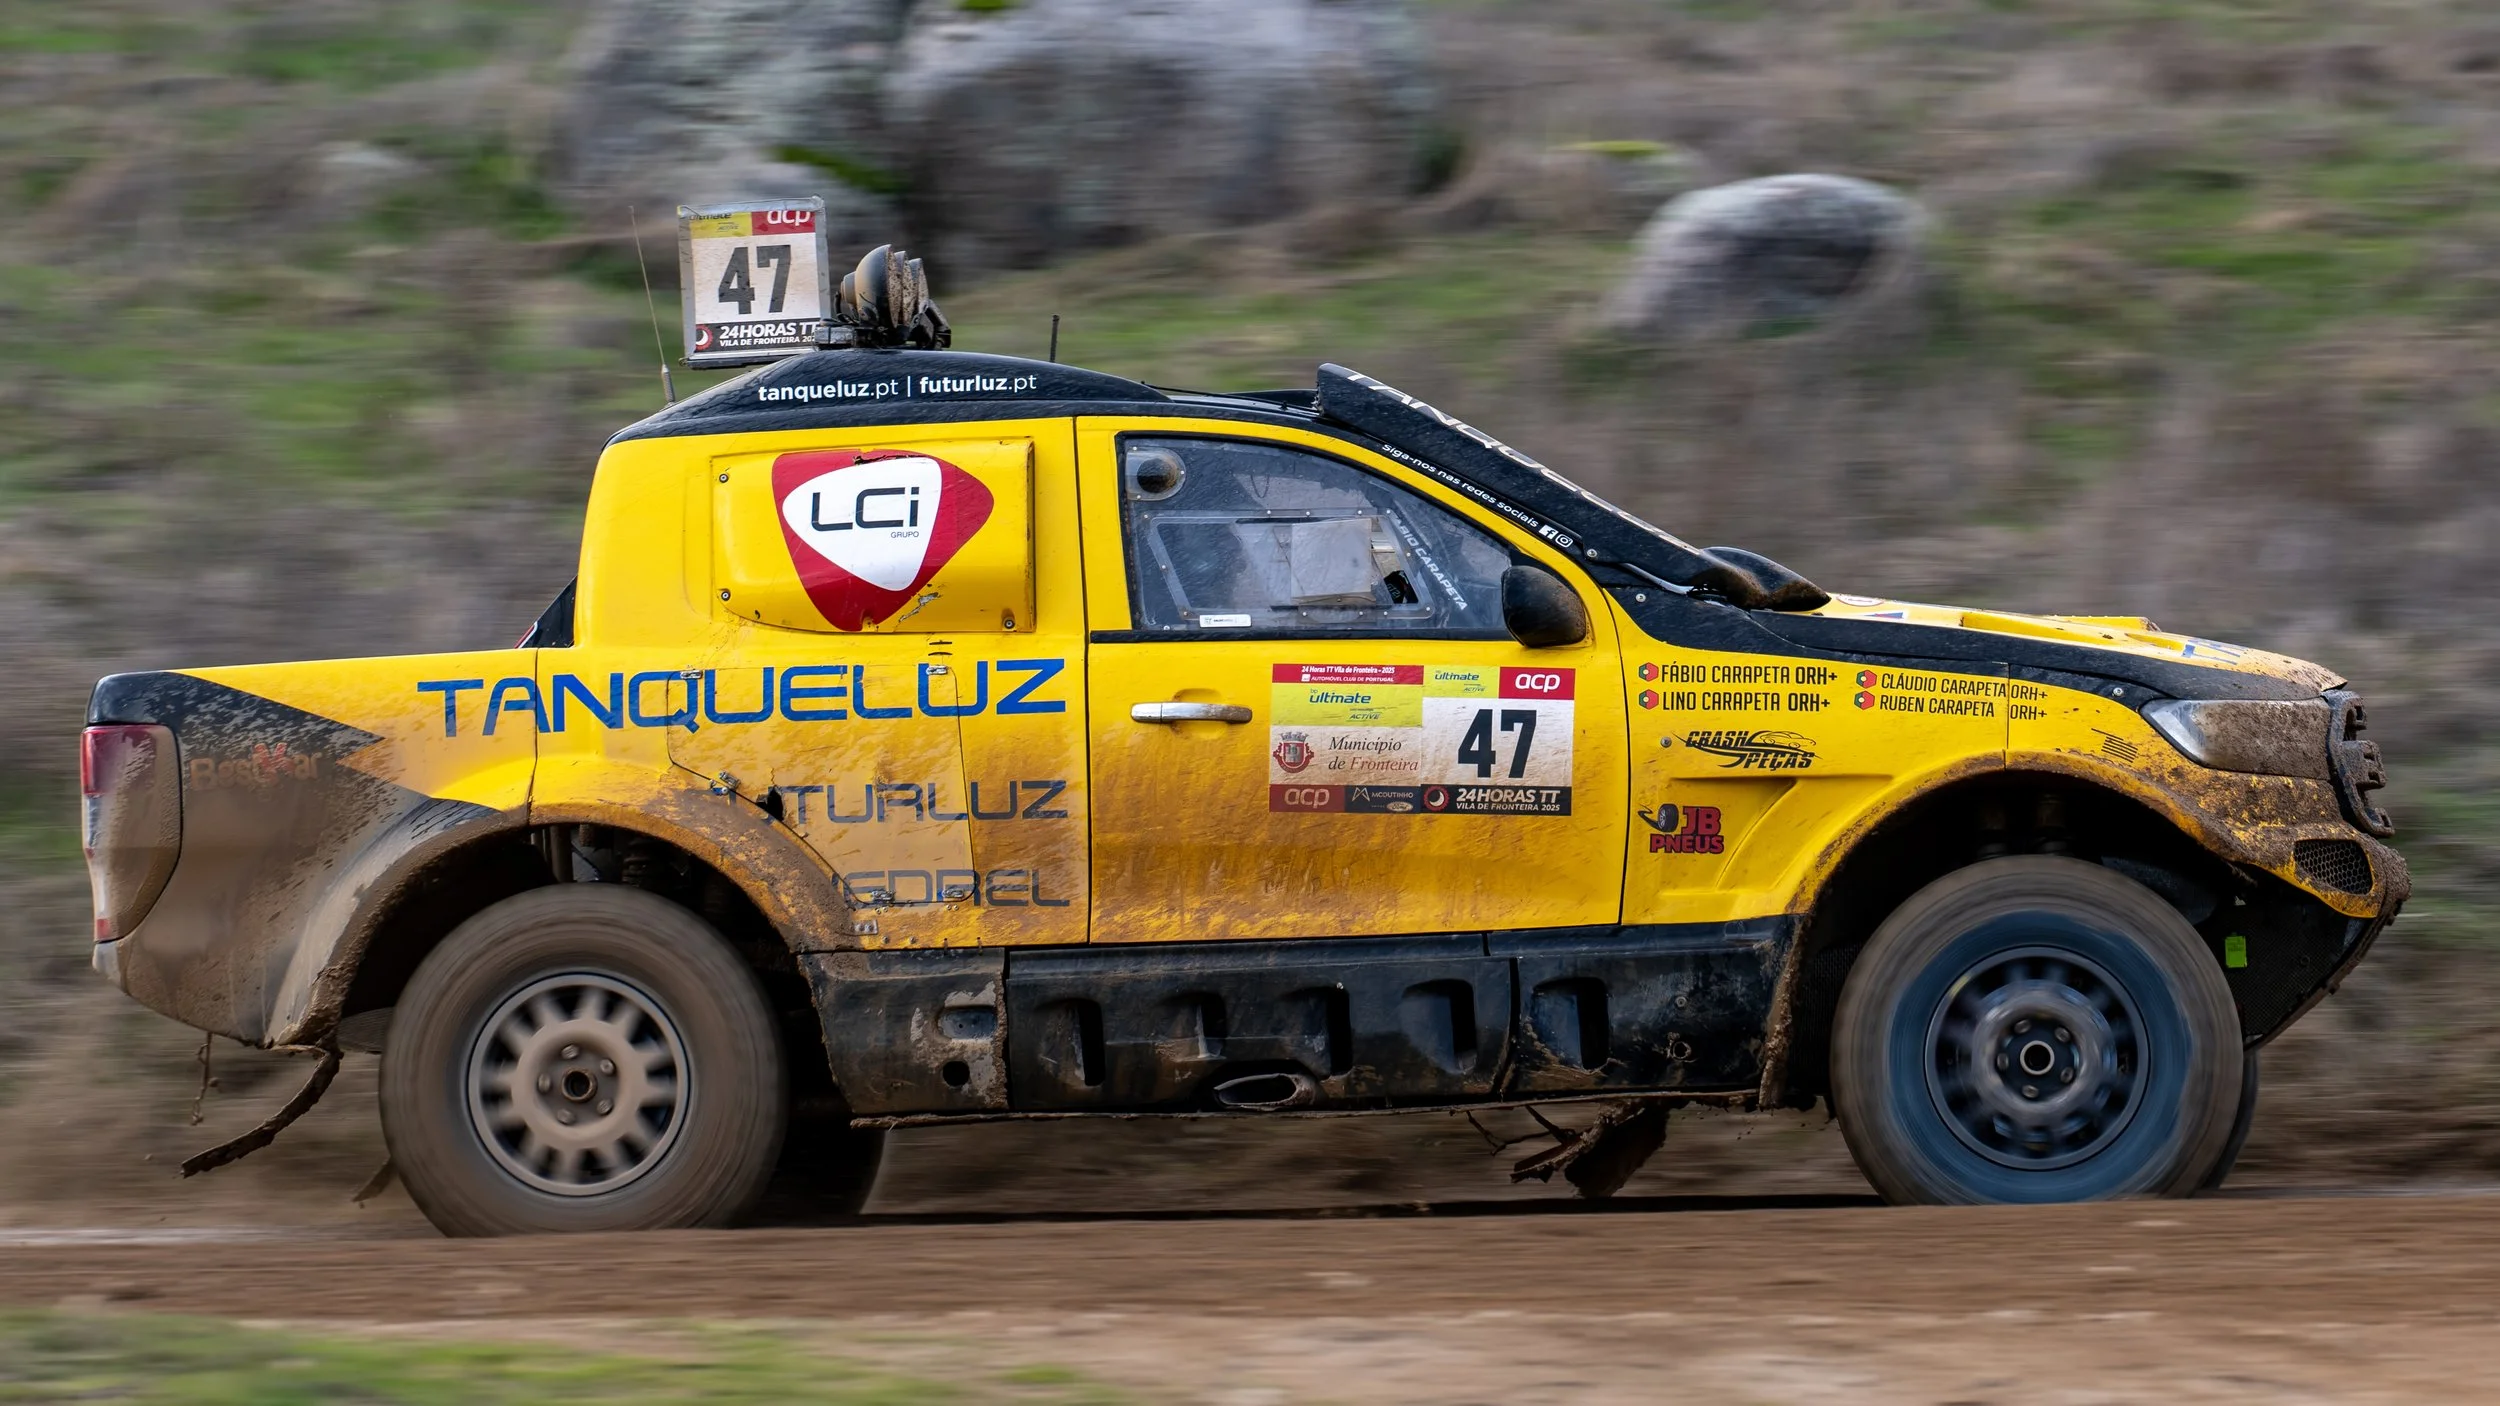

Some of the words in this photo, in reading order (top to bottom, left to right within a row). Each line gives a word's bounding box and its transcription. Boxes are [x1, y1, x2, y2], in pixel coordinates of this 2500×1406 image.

[767, 210, 811, 227] acp
[718, 244, 791, 315] 47
[799, 321, 820, 336] TT
[719, 339, 739, 347] VILA
[753, 336, 801, 346] FRONTEIRA
[802, 335, 816, 343] 202
[758, 379, 899, 402] tanqueluz.pt
[919, 373, 1037, 394] futurluz.pt
[1437, 469, 1461, 486] nas
[1461, 481, 1497, 504] redes
[1496, 501, 1539, 528] sociais
[890, 531, 920, 539] GRUPO
[1415, 547, 1468, 611] CARAPETA
[1353, 666, 1378, 674] Fronteira
[1382, 666, 1395, 674] 2025
[1661, 661, 1706, 683] FÁBIO
[1711, 665, 1790, 684] CARAPETA
[1795, 666, 1838, 685] ORH+
[1435, 672, 1479, 681] ultimate
[1515, 673, 1561, 693] acp
[1881, 672, 1937, 692] CLÁUDIO
[1940, 678, 2007, 698] CARAPETA
[2010, 684, 2048, 701] ORH+
[417, 658, 1066, 738] TANQUELUZ
[1309, 692, 1371, 704] ultimate
[1662, 691, 1696, 711] LINO
[1702, 692, 1780, 711] CARAPETA
[1787, 693, 1831, 712] ORH+
[1880, 694, 1925, 713] RUBEN
[1928, 698, 1995, 717] CARAPETA
[2009, 704, 2048, 720] ORH+
[1328, 736, 1402, 754] Município
[1458, 708, 1537, 779] 47
[1685, 730, 1750, 748] CRASH
[1328, 756, 1346, 771] de
[1350, 757, 1419, 771] Fronteira
[1743, 751, 1815, 771] PEÇAS
[1284, 788, 1330, 809] acp
[1371, 791, 1414, 799] MCOUTINHO
[1539, 790, 1561, 804] TT
[1456, 802, 1476, 810] VILA
[1490, 803, 1539, 811] FRONTEIRA
[1541, 804, 1561, 812] 2025
[1681, 806, 1722, 835] JB
[1649, 833, 1725, 854] PNEUS
